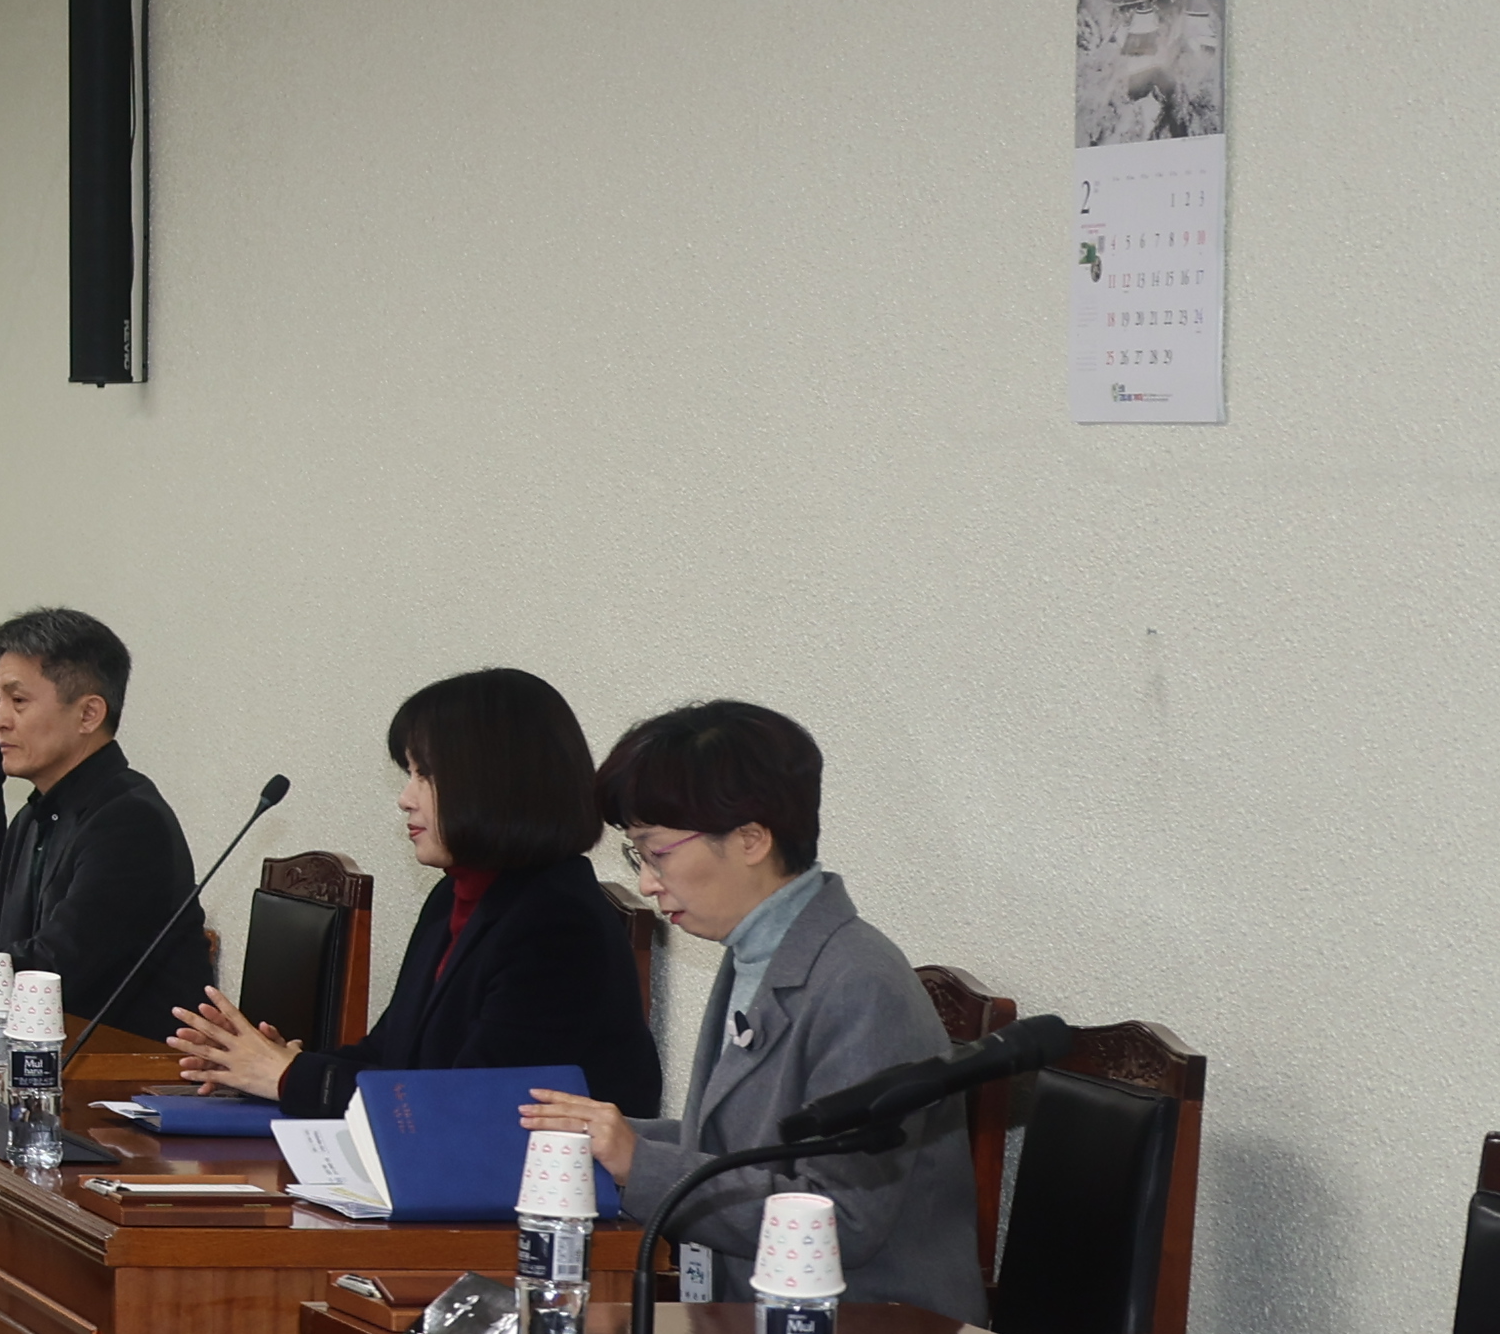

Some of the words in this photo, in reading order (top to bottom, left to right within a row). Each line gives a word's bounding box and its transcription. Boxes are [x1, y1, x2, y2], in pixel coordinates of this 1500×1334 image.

[1080, 180, 1091, 214] 2
[24, 1059, 44, 1068] Mul
[786, 1319, 815, 1332] Mul
